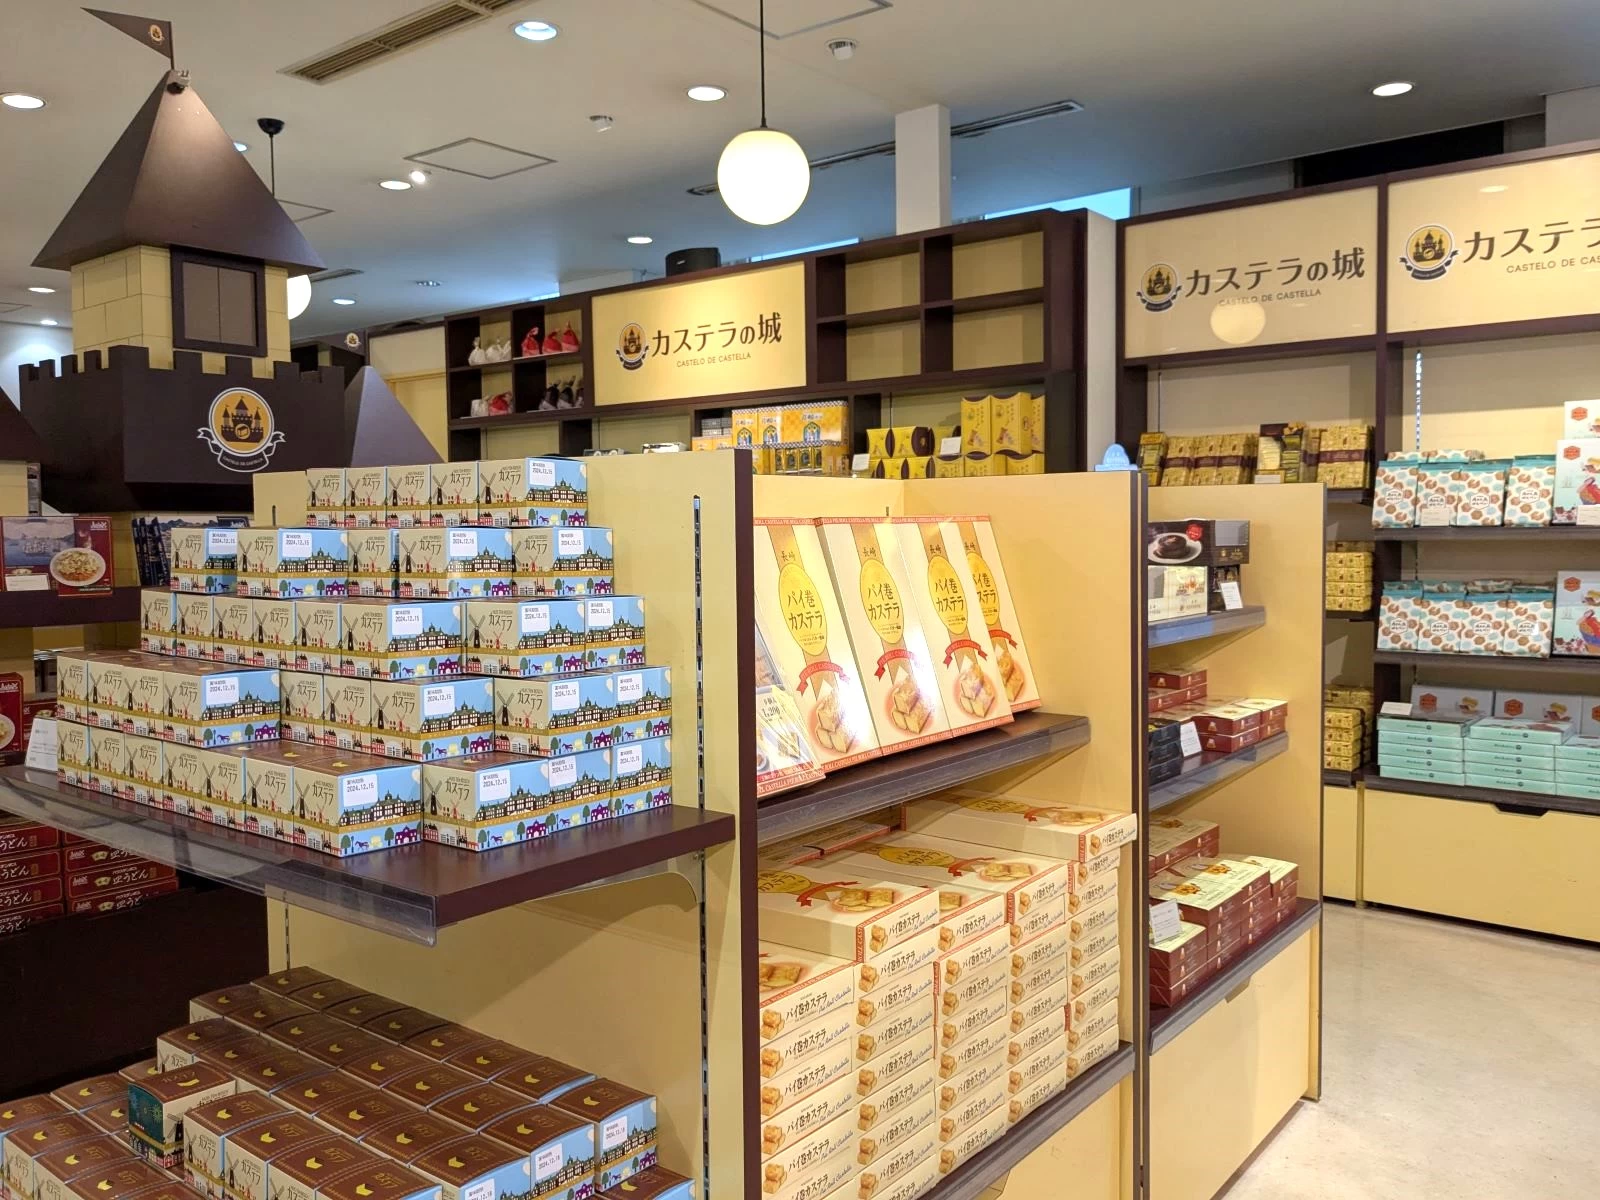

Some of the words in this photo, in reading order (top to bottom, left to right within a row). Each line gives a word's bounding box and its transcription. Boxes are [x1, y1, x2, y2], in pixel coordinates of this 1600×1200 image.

[1185, 247, 1365, 298] カステラの城
[1506, 260, 1557, 274] CASTELO
[1561, 258, 1575, 267] DE
[1261, 294, 1272, 302] DE
[1276, 289, 1321, 301] CASTELLA
[652, 312, 782, 358] カステラの城
[676, 358, 705, 368] CASTELO
[707, 356, 716, 364] DE
[718, 353, 751, 363] CASTELLA
[867, 583, 893, 601] パイ巻
[935, 577, 957, 594] パイ巻
[787, 589, 816, 609] パイ巻
[936, 596, 964, 612] カステラ
[788, 610, 823, 630] カステラ
[868, 602, 900, 621] カステラ
[347, 782, 375, 793] 2024.12.15
